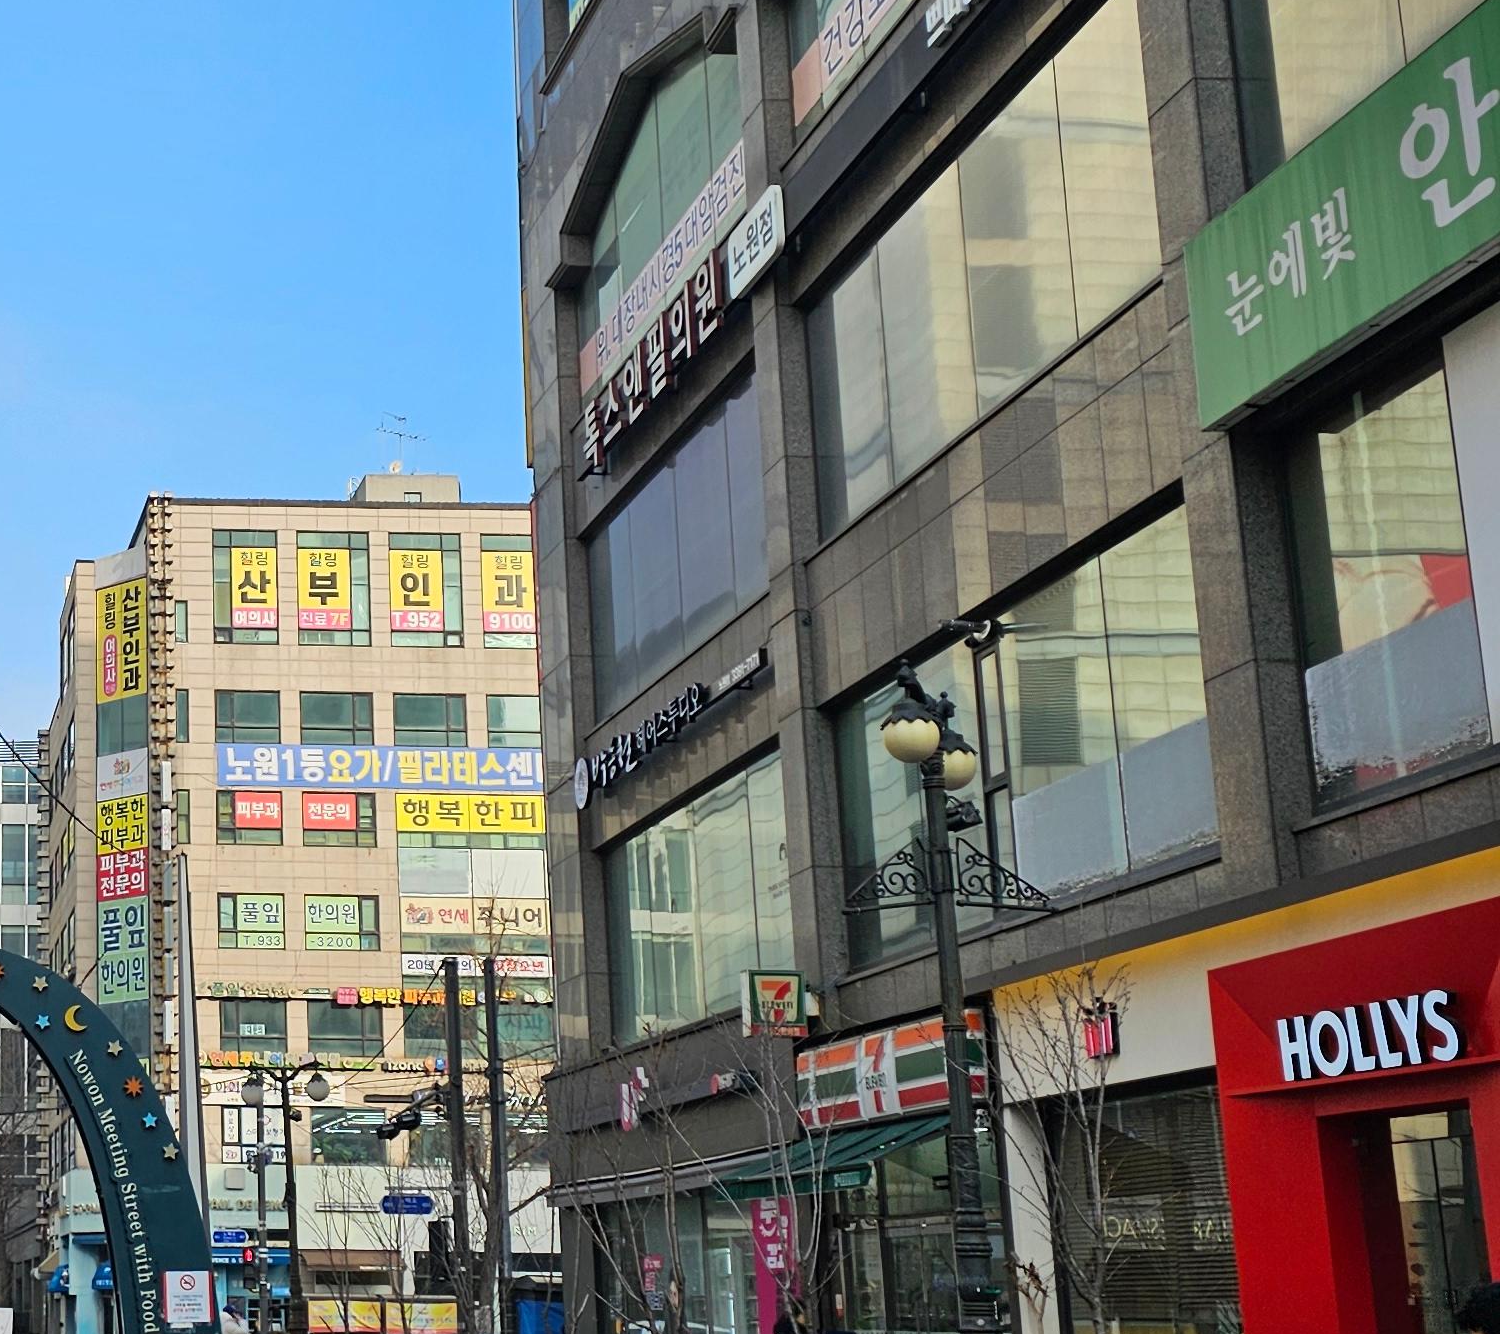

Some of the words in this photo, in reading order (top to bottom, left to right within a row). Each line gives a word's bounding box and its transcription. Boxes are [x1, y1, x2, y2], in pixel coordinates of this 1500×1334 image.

[732, 200, 774, 280] 노원점
[1224, 186, 1357, 338] 눈에빛
[235, 611, 276, 626] 여의사
[300, 612, 329, 626] 진료
[331, 612, 349, 626] 7F
[392, 612, 441, 629] T.952
[488, 613, 535, 630] 9100
[122, 585, 142, 693] 산부인과
[105, 637, 117, 683] 여의사
[100, 798, 145, 829] 행복한
[236, 801, 280, 819] 피부과
[307, 803, 350, 820] 전문의
[100, 824, 145, 851] 피부과
[100, 848, 146, 876] 피부과
[100, 872, 146, 898] 전문의
[241, 901, 281, 924] 풀잎
[308, 902, 357, 925] 한의원
[438, 907, 470, 925] 연세
[101, 903, 146, 953] 풀잎
[242, 934, 281, 947] T.933
[100, 958, 146, 995] 한의원
[359, 987, 402, 1004] 행복한
[1276, 989, 1460, 1083] HOLLYS
[70, 1048, 106, 1107] Nowon
[98, 1107, 130, 1178] Meeting
[121, 1182, 143, 1238] Street
[133, 1243, 151, 1284] with
[139, 1289, 160, 1334] Food
